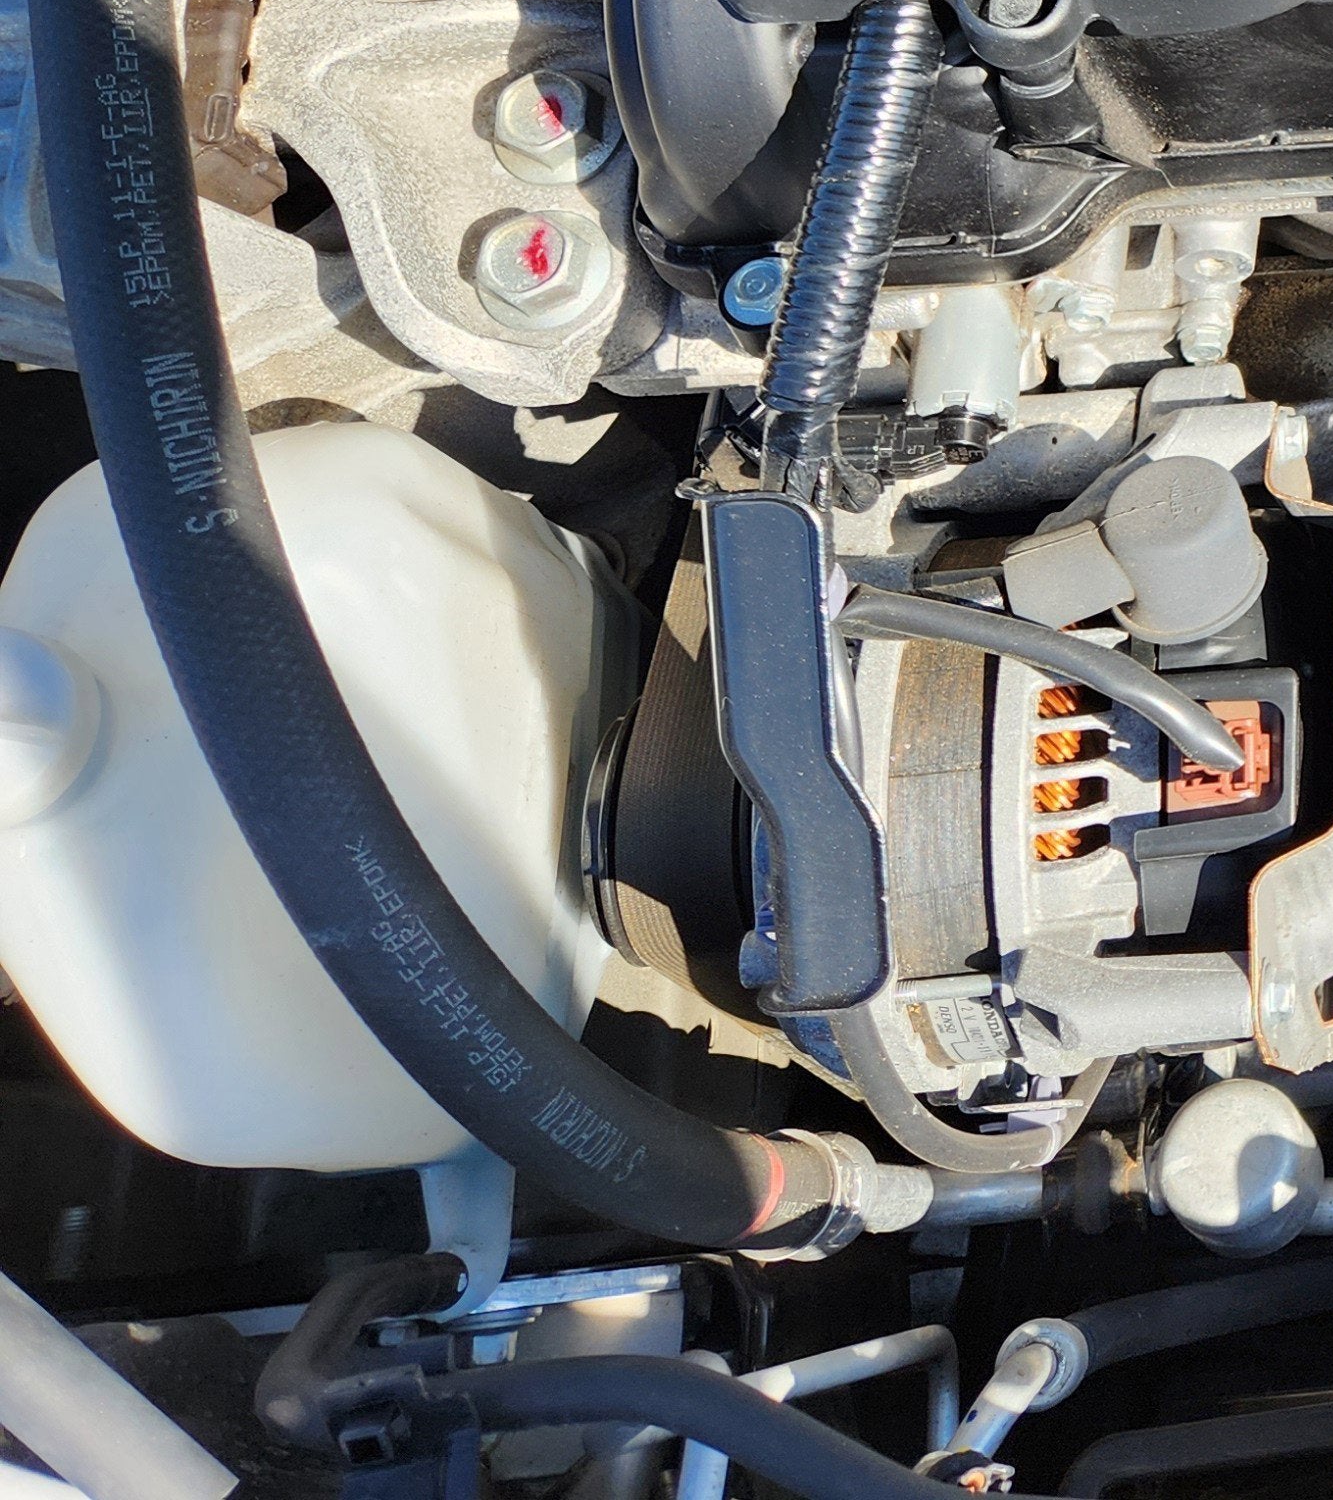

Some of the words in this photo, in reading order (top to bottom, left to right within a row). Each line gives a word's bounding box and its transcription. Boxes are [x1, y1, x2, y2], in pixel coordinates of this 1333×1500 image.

[118, 241, 152, 308] 15LP
[938, 1005, 958, 1035] DENSO
[467, 1046, 520, 1097] 15LP
